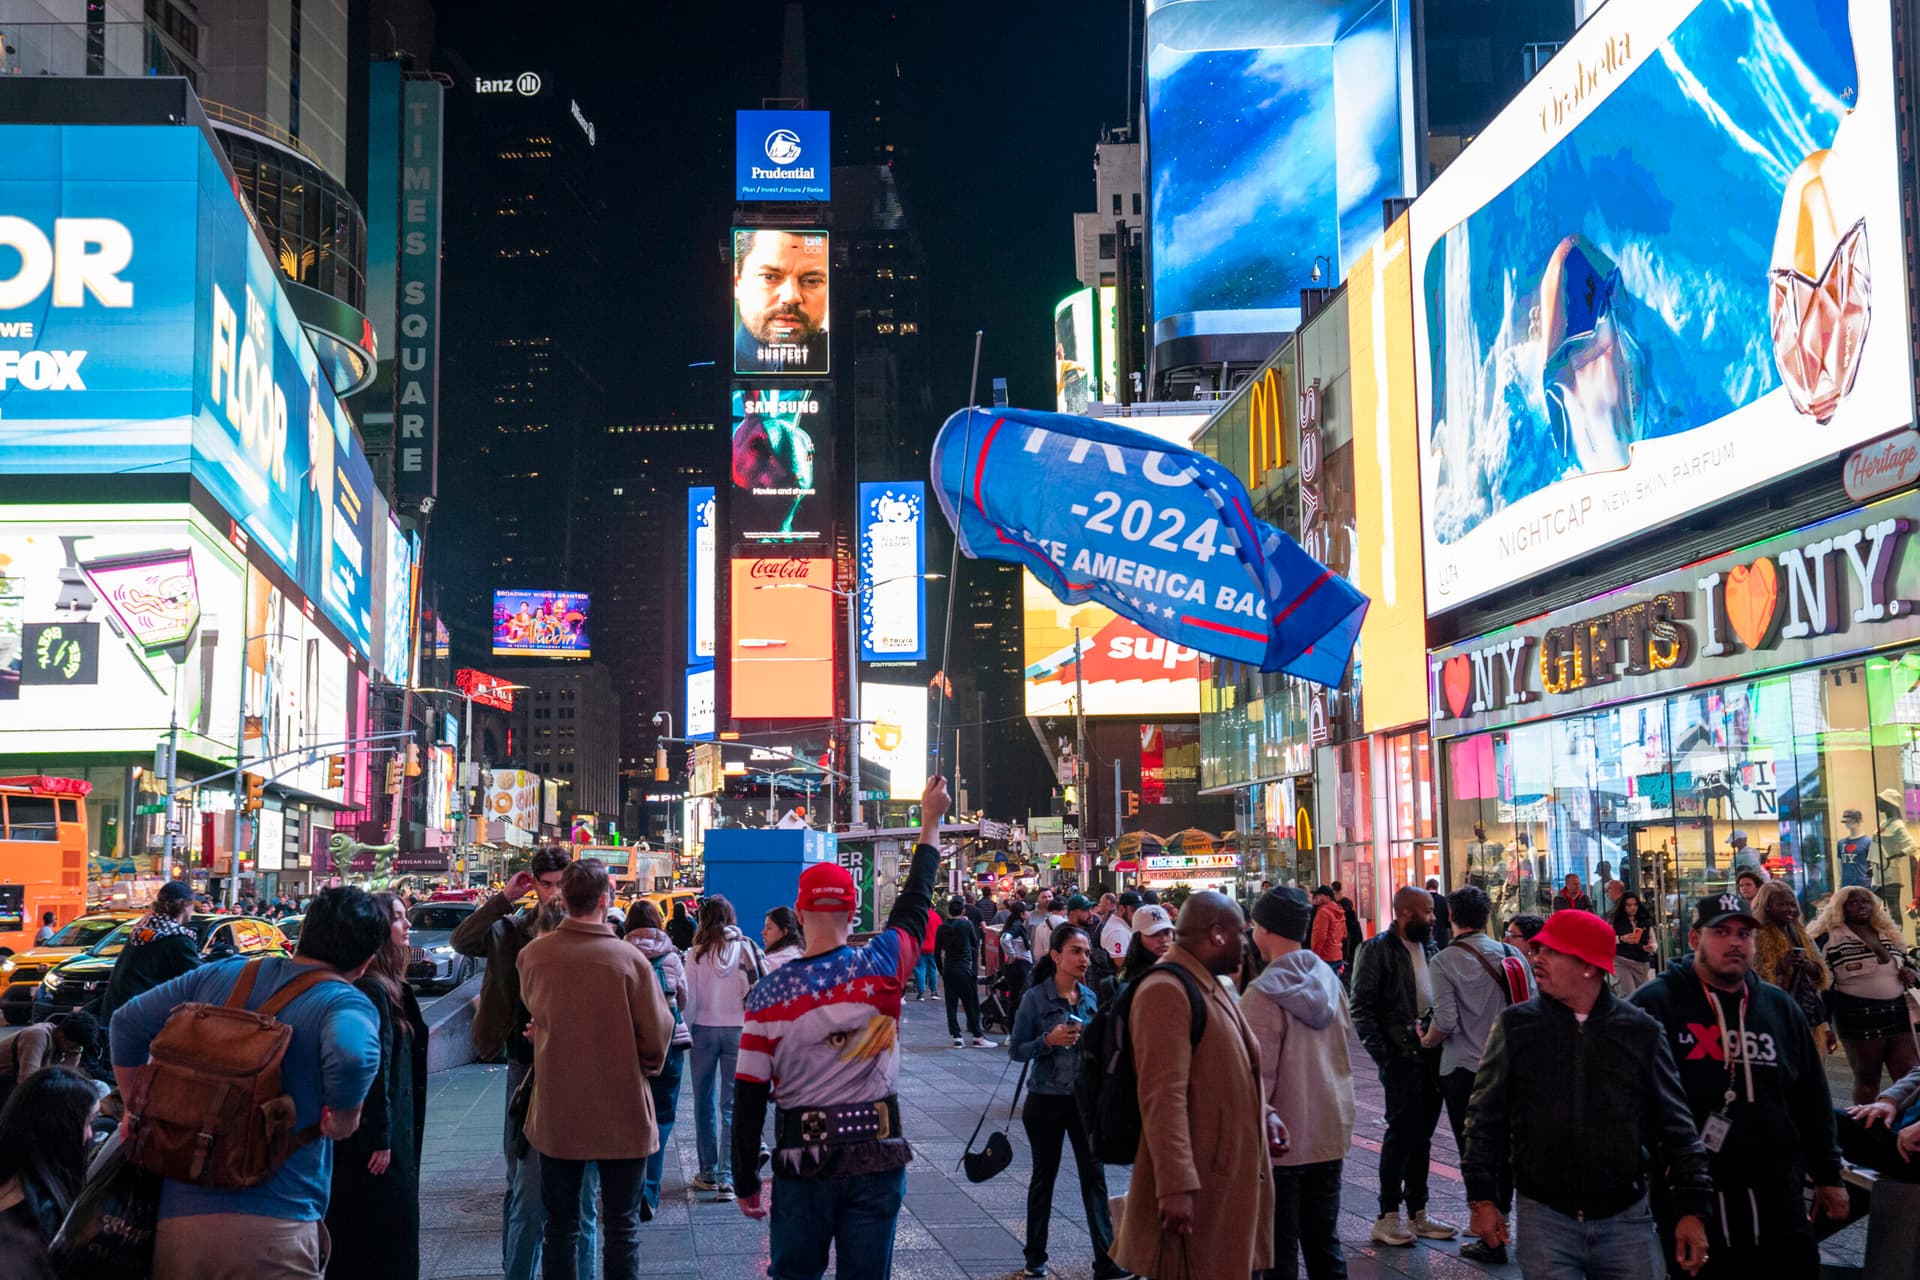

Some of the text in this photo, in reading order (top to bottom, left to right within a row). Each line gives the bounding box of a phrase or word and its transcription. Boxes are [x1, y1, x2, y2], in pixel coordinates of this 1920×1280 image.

[404, 103, 431, 256] TIMES
[751, 167, 815, 179] Prudential
[0, 350, 88, 391] FOX
[757, 346, 809, 362] SUSPECT
[212, 282, 288, 490] FLOOR
[400, 280, 428, 473] SQUARE
[744, 400, 819, 414] SAMSUNG
[1851, 443, 1917, 489] Heritage
[753, 487, 777, 496] Movies
[777, 487, 792, 496] and
[1500, 496, 1591, 560] NIGHTCAP
[1673, 441, 1735, 484] PARFUM
[1072, 548, 1206, 605] AMERICA
[496, 590, 532, 598] BROADWAY
[505, 619, 577, 645] Aladdin
[1540, 593, 1681, 695] GIFTS
[1114, 942, 1122, 954] 3
[1679, 1032, 1694, 1044] LA
